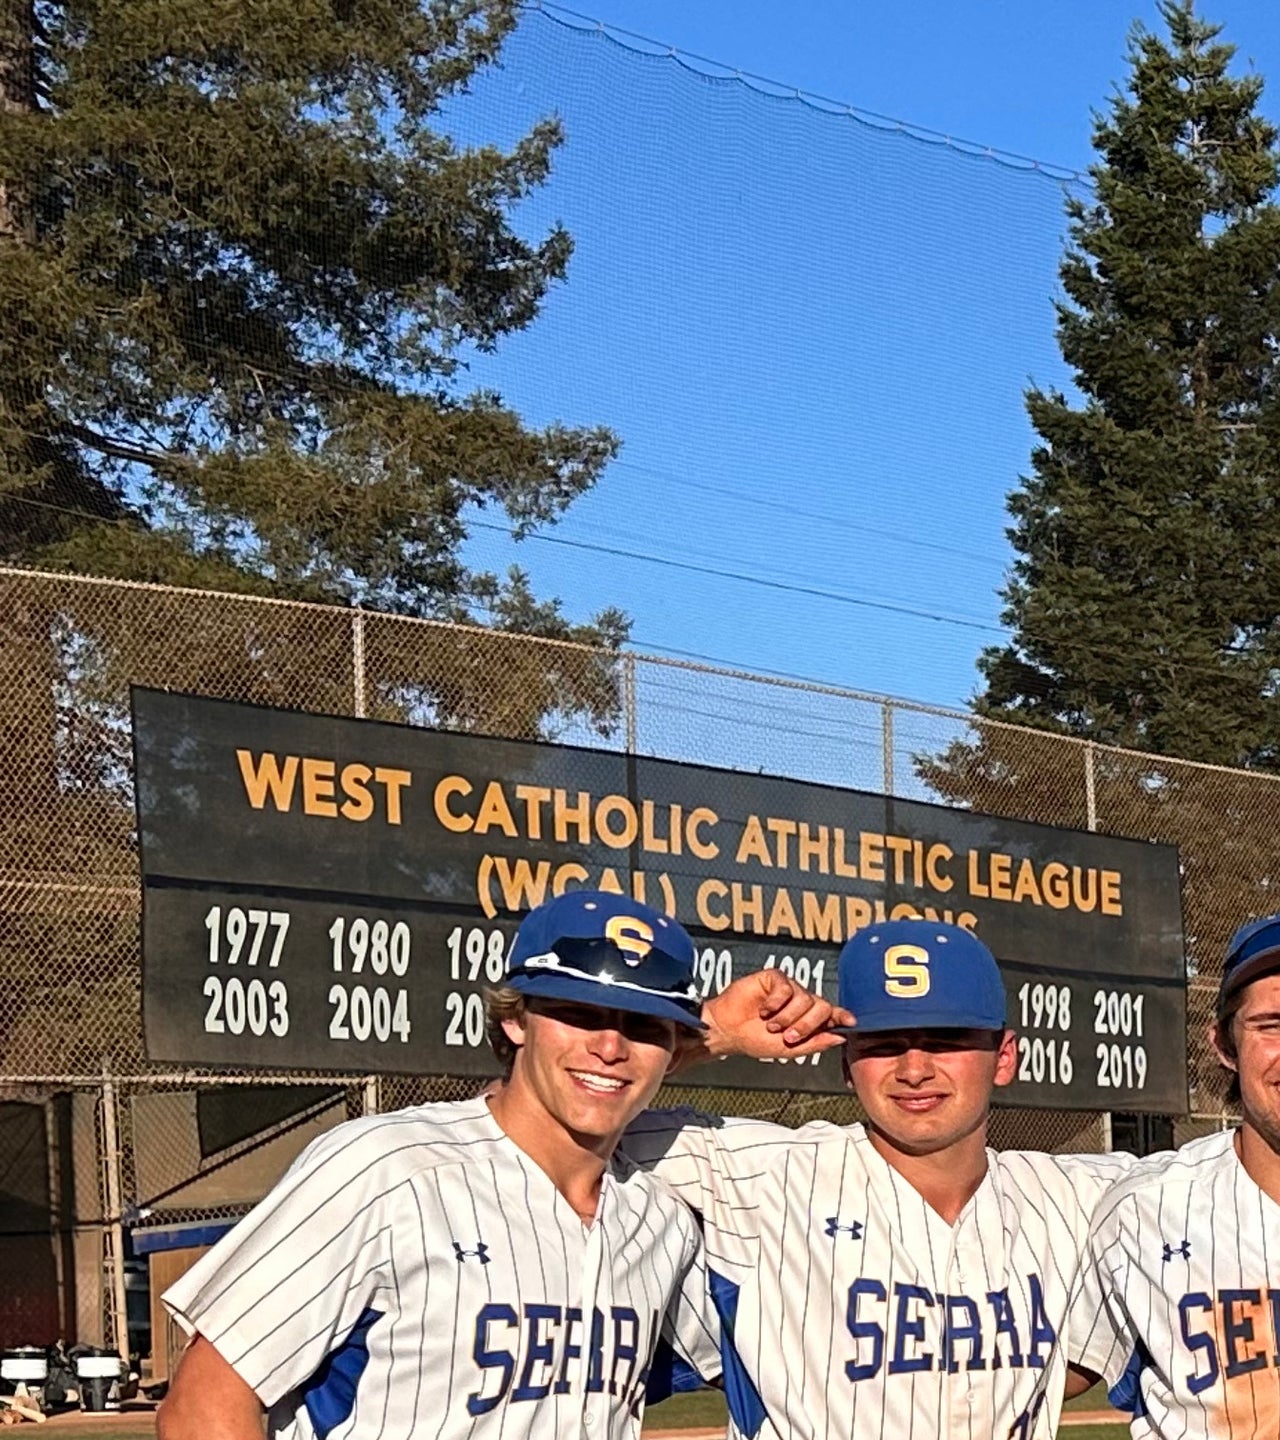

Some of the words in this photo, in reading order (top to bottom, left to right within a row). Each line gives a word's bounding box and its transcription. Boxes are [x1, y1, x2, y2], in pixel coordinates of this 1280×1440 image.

[236, 748, 411, 825] WEST
[434, 775, 719, 861] CATHOLIC
[736, 815, 955, 893] ATHLETIC
[968, 849, 1123, 917] LEAGUE
[204, 906, 290, 968] 1977
[328, 917, 411, 977] 1980
[446, 926, 519, 984] 198
[1018, 983, 1071, 1033] 1998
[1093, 990, 1144, 1038] 2001
[884, 944, 930, 998] S
[203, 976, 289, 1038] 2003
[328, 985, 411, 1044] 2004
[445, 991, 485, 1047] 20
[1018, 1038, 1073, 1085] 2016
[1096, 1044, 1147, 1090] 2019
[844, 1273, 1056, 1384] SERRA
